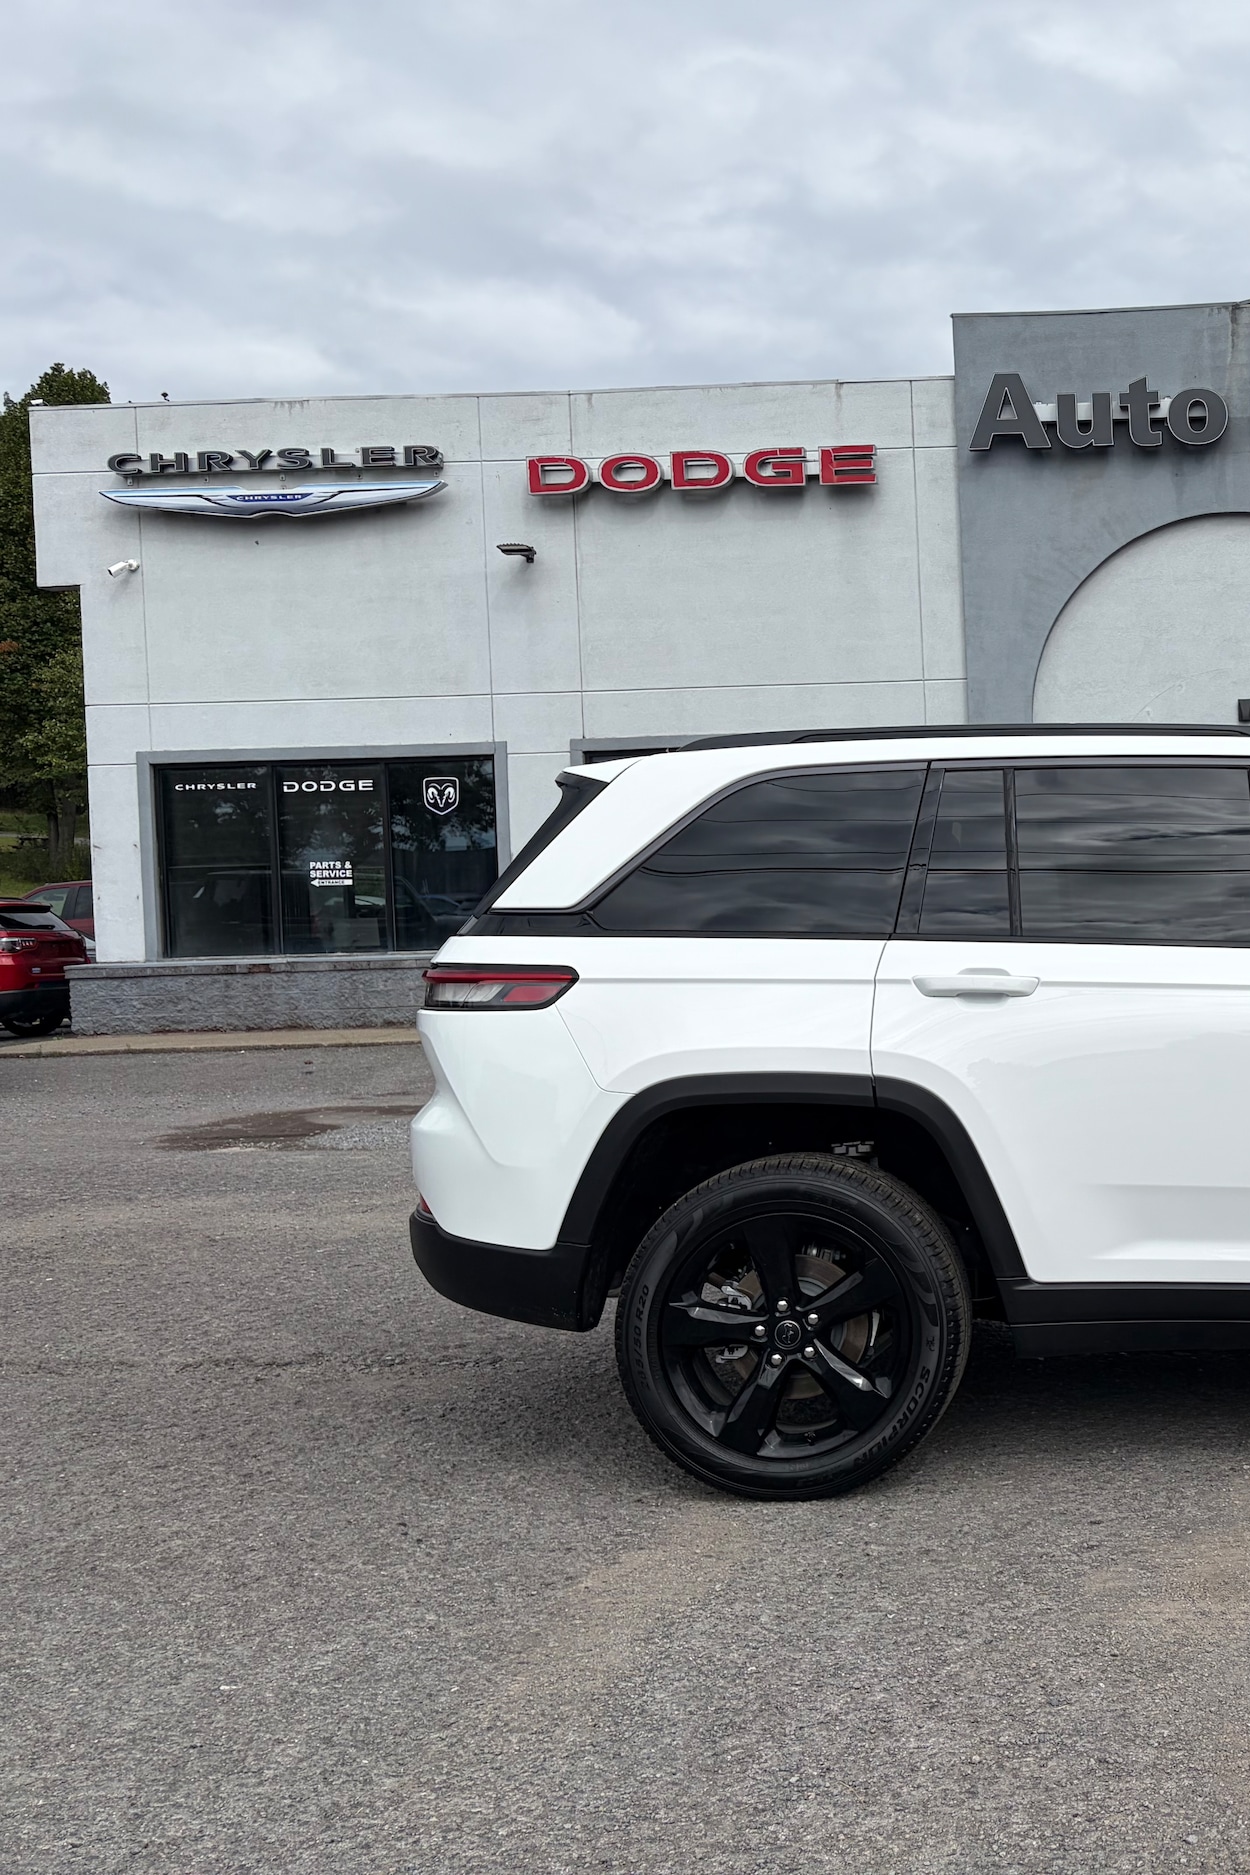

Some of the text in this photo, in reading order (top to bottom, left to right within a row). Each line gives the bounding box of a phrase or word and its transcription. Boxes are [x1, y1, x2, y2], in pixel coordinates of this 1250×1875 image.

[968, 371, 1229, 451] Auto
[107, 445, 442, 475] CHRYSLER
[526, 445, 878, 495] DODGE
[235, 494, 302, 502] CHRYSLER
[174, 782, 257, 791] CHRYSLER
[282, 779, 374, 793] DODGE
[310, 861, 352, 869] PARTS &
[310, 869, 353, 878] SERVICE
